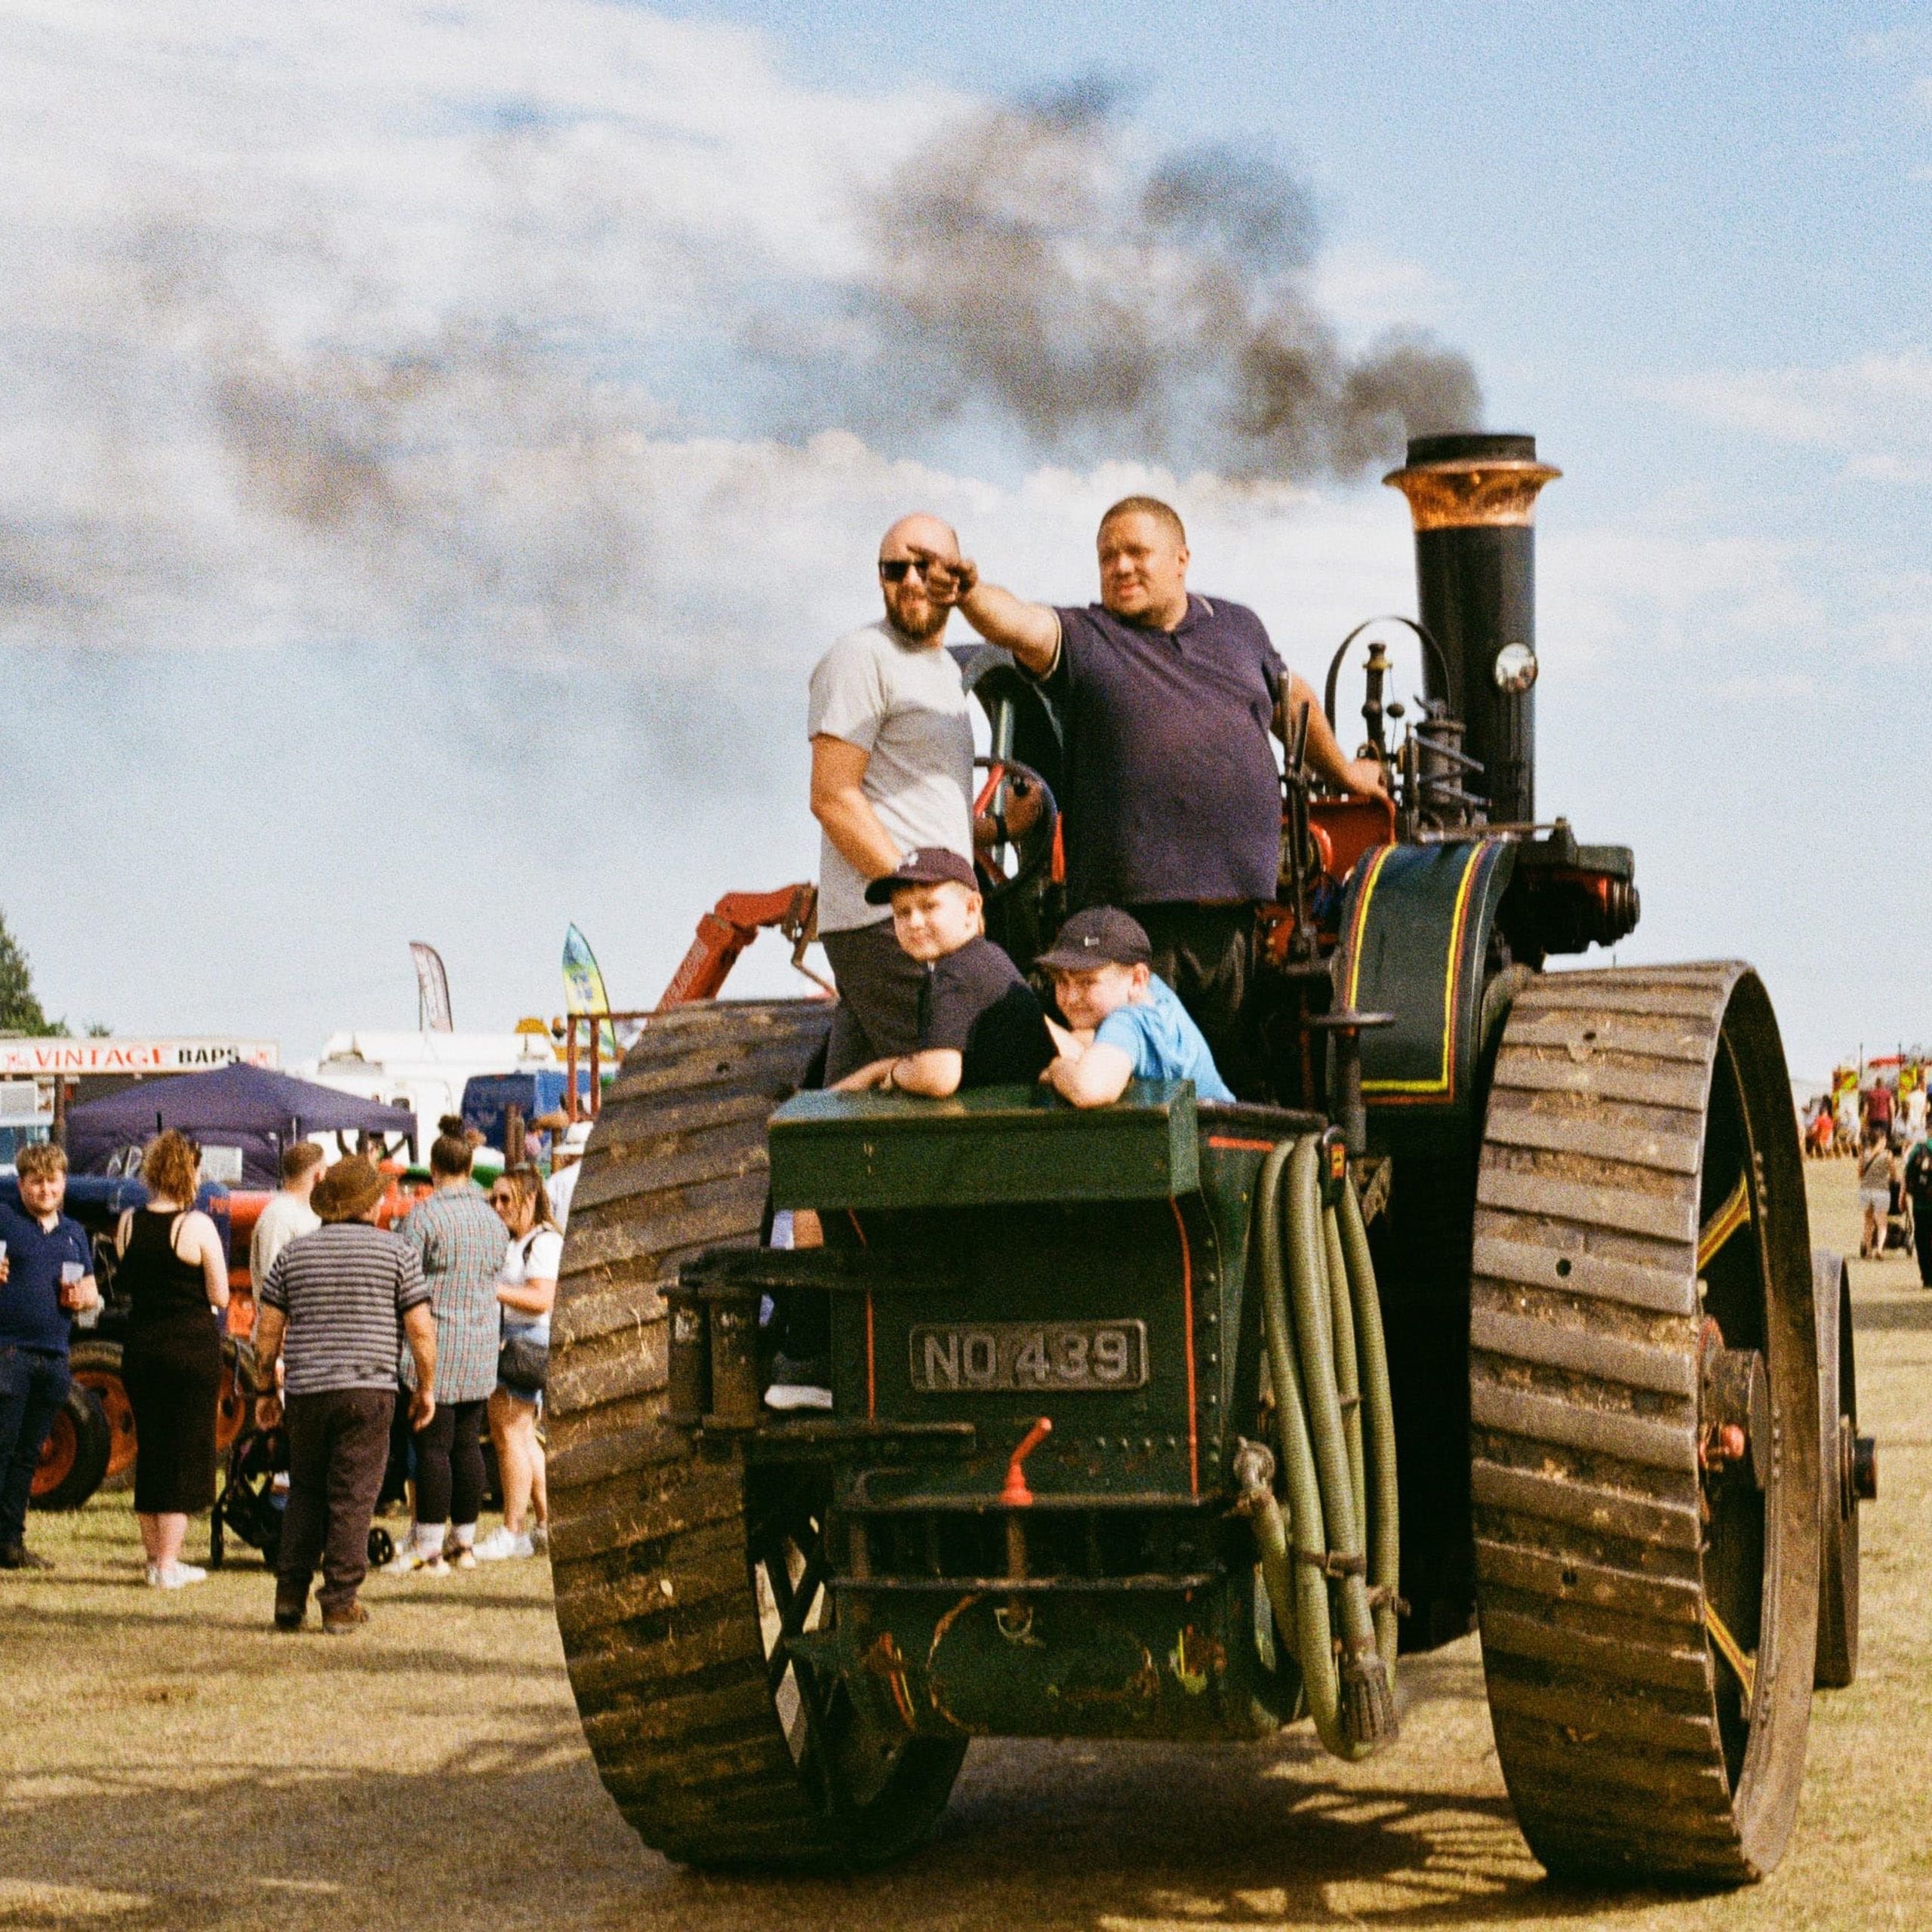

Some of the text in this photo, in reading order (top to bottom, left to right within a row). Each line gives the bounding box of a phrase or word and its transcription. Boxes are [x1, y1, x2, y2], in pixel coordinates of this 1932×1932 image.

[34, 1048, 169, 1066] VINTAGE
[924, 1330, 1128, 1389] NO 439
